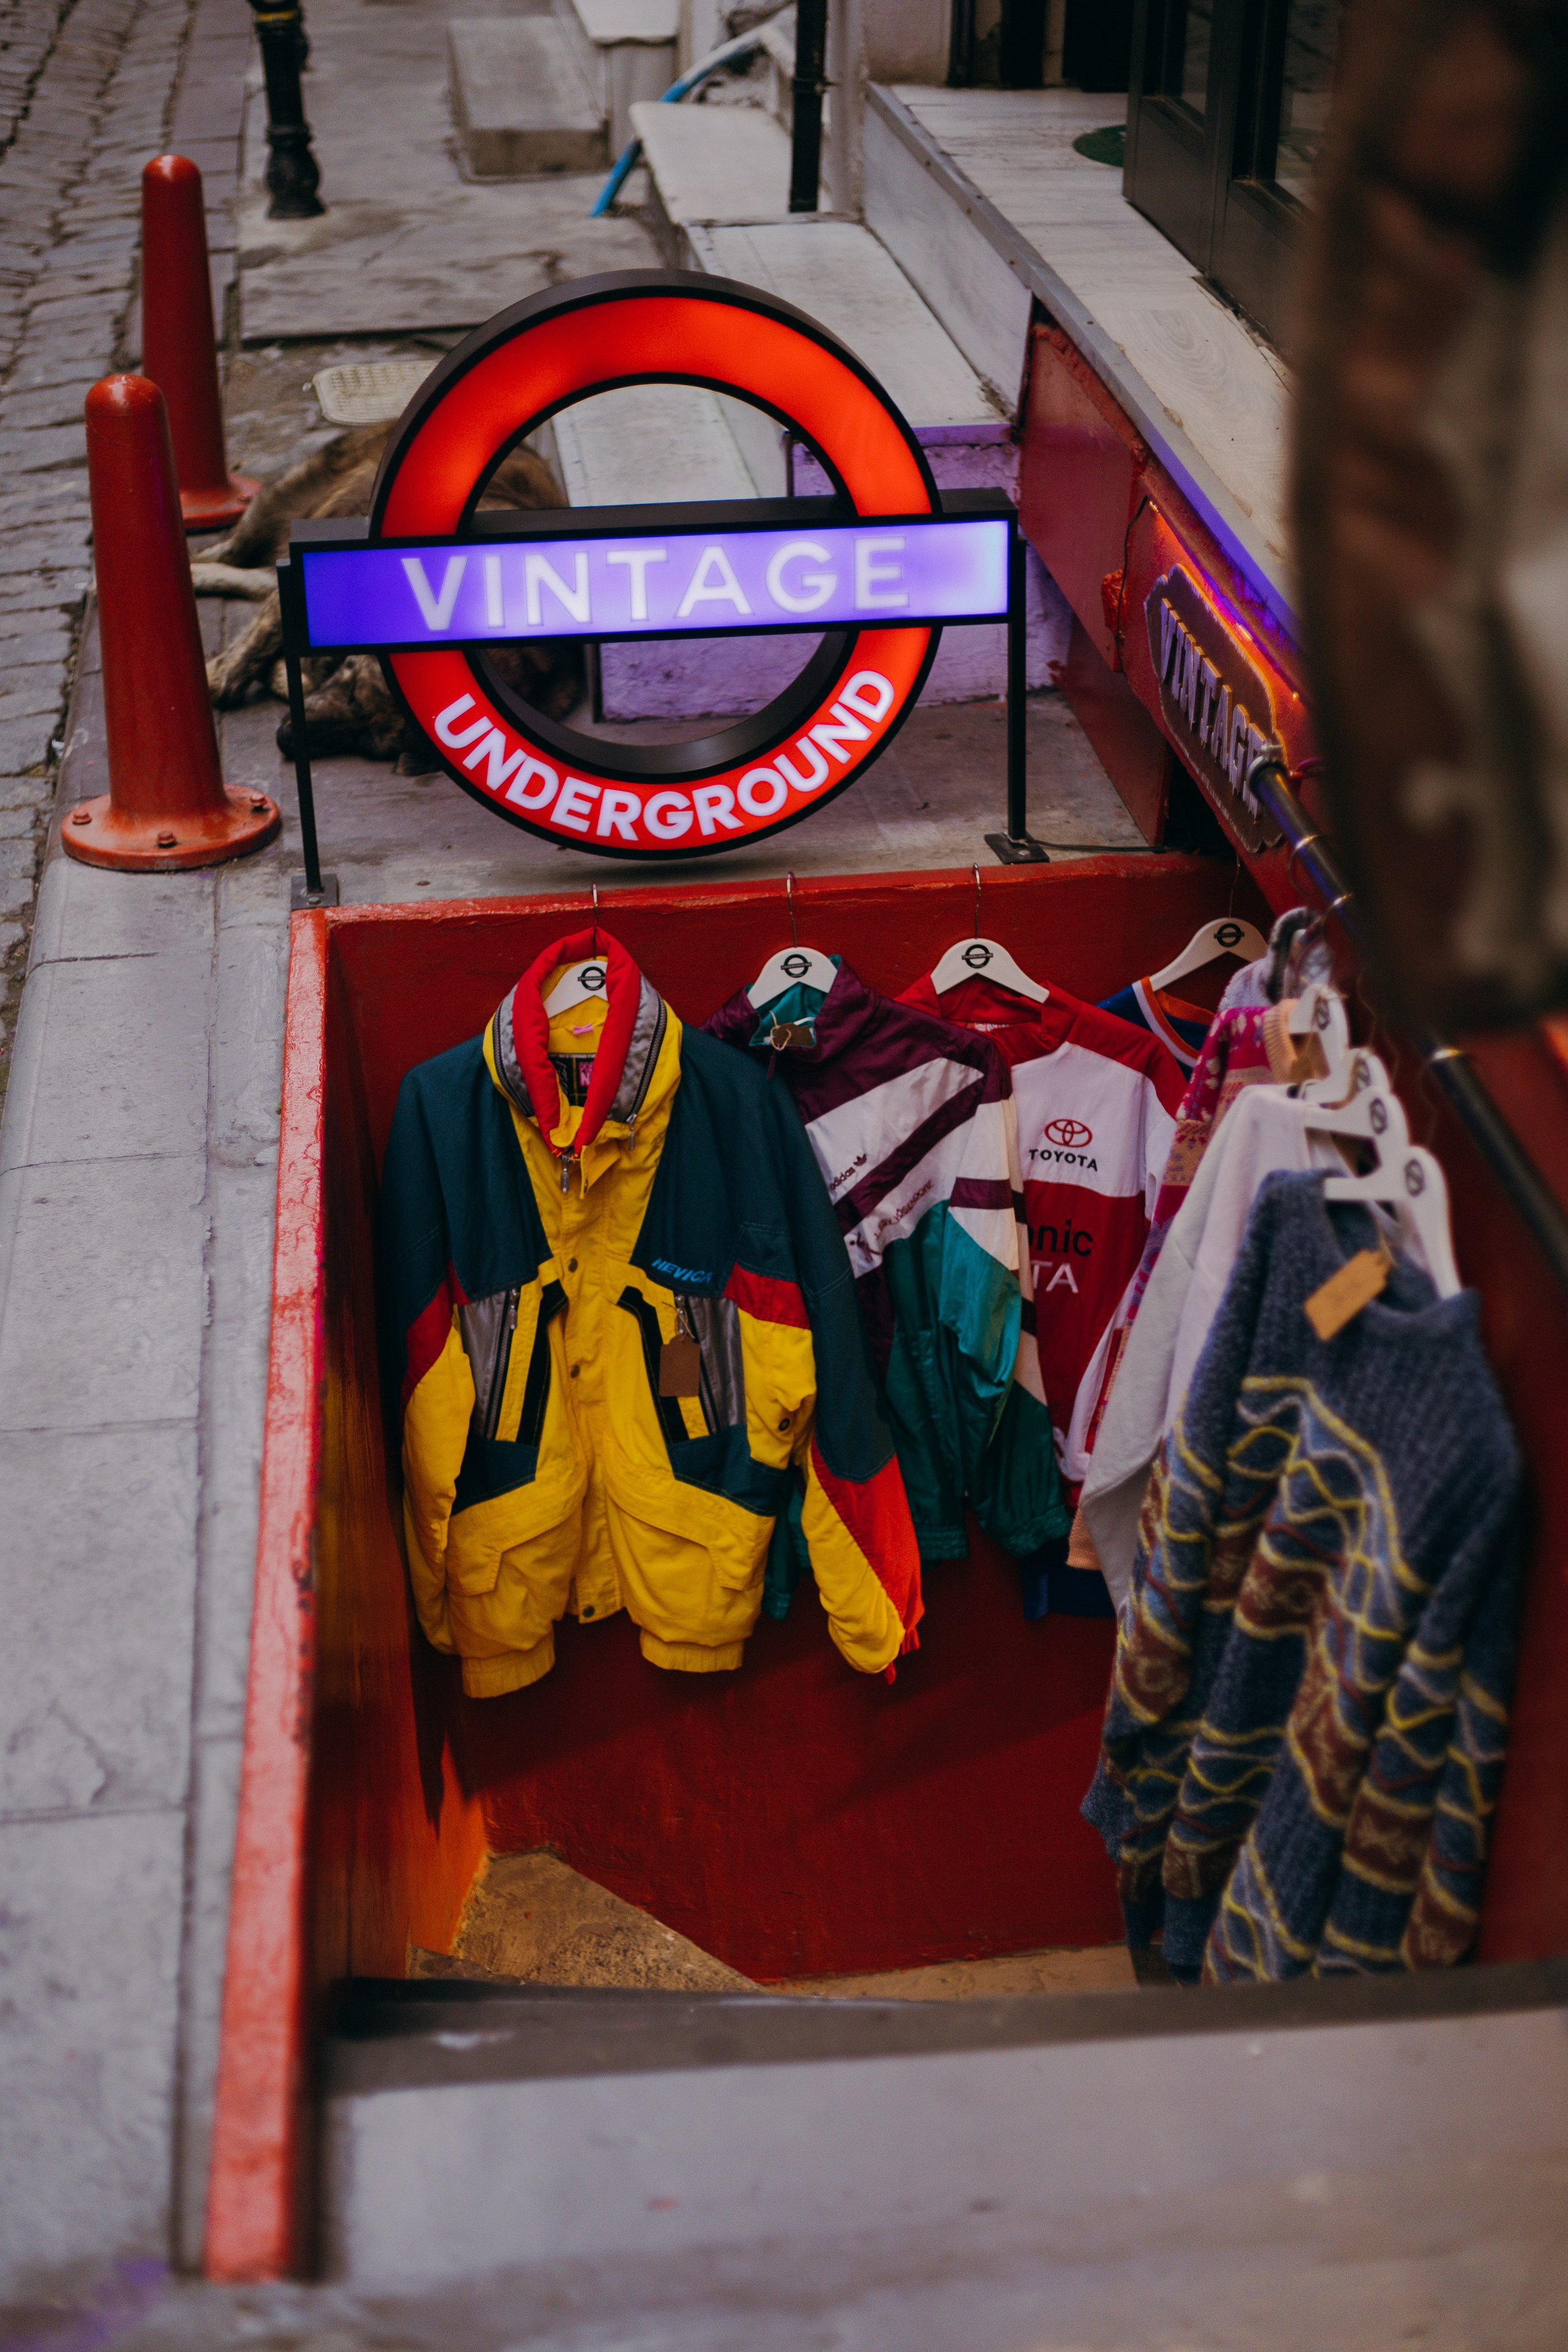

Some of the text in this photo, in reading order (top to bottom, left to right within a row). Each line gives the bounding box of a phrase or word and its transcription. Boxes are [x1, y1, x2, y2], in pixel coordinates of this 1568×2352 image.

[402, 536, 910, 631] VINTAGE
[433, 670, 895, 842] UNDERGROUND
[1029, 1149, 1098, 1172] TOYOTA
[829, 1167, 856, 1190] adidas
[1028, 1219, 1093, 1257] nic
[652, 1257, 714, 1284] NEVICA
